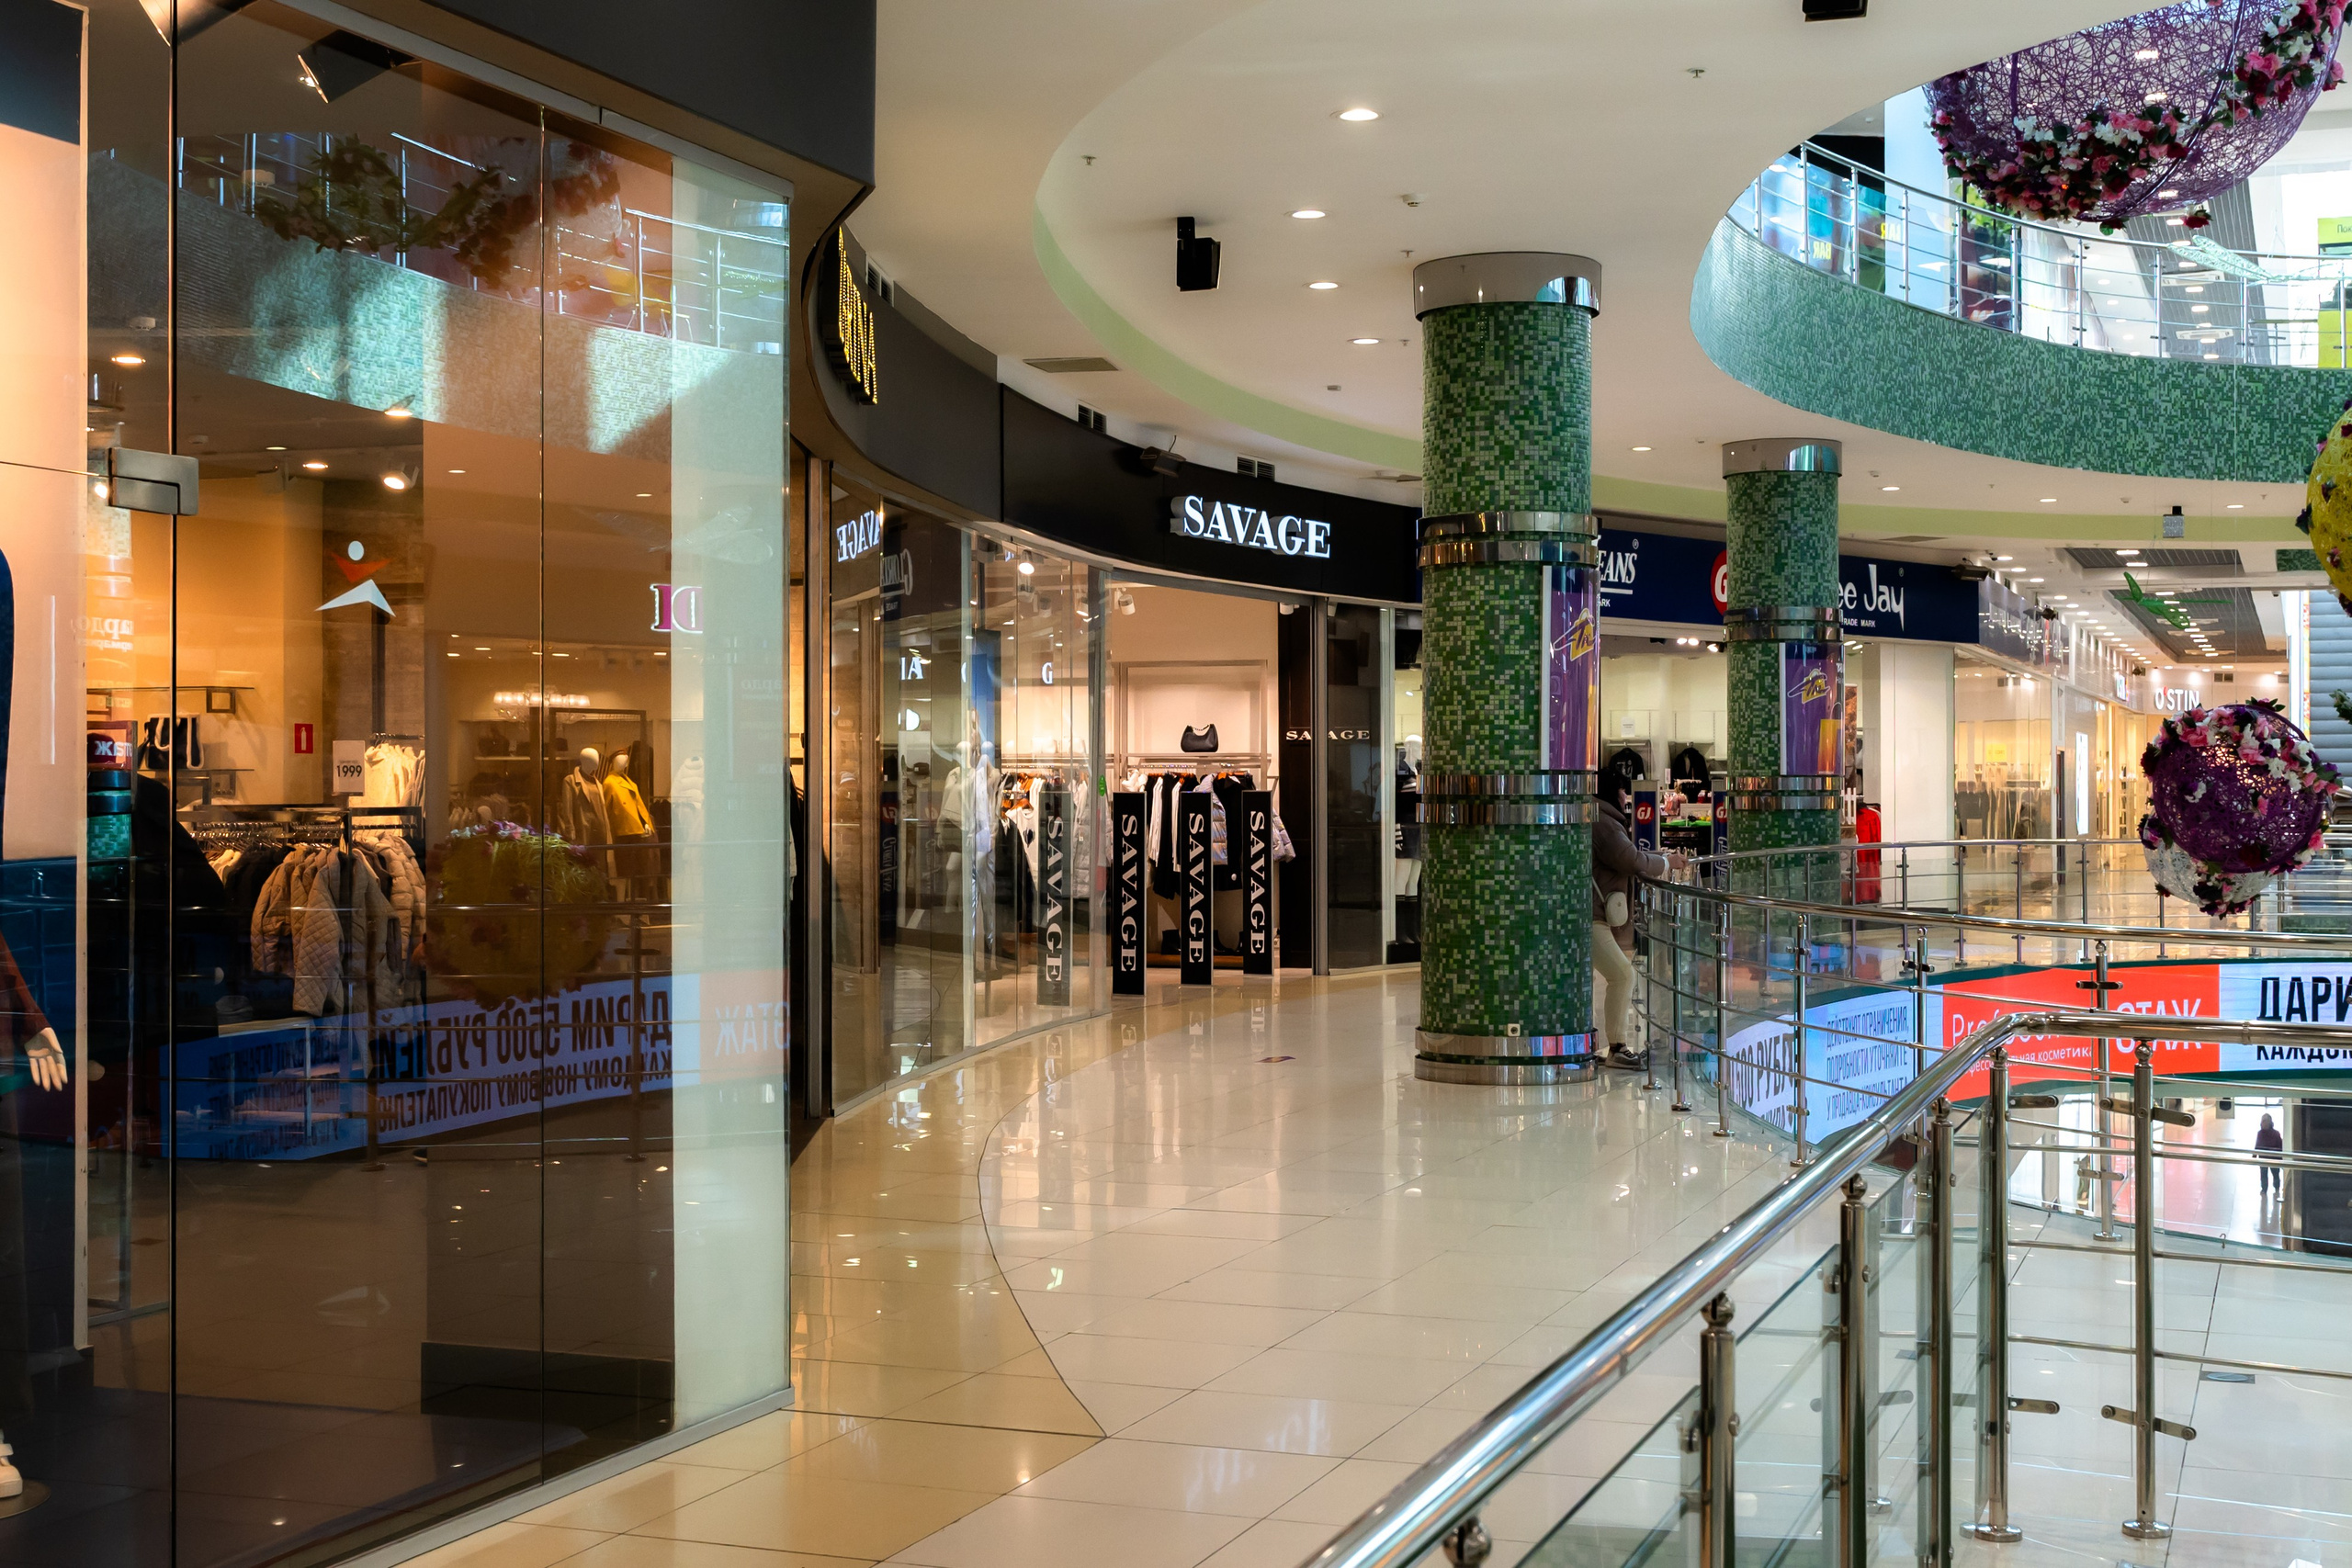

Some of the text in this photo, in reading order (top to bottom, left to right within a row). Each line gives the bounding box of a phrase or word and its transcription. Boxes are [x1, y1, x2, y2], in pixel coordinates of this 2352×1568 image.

[1183, 495, 1330, 558] SAVAGE
[1596, 544, 1637, 584] EANS
[1860, 619, 1876, 627] MARK
[1863, 563, 1905, 631] Jay
[1286, 730, 1370, 740] SAAGE
[337, 765, 362, 777] 1999
[1637, 807, 1651, 820] GJ
[1046, 815, 1064, 982] SAVAGE
[1121, 814, 1137, 972] SAVAGE
[1189, 813, 1204, 963] SAVAGE
[1250, 810, 1265, 954] SAVAGE
